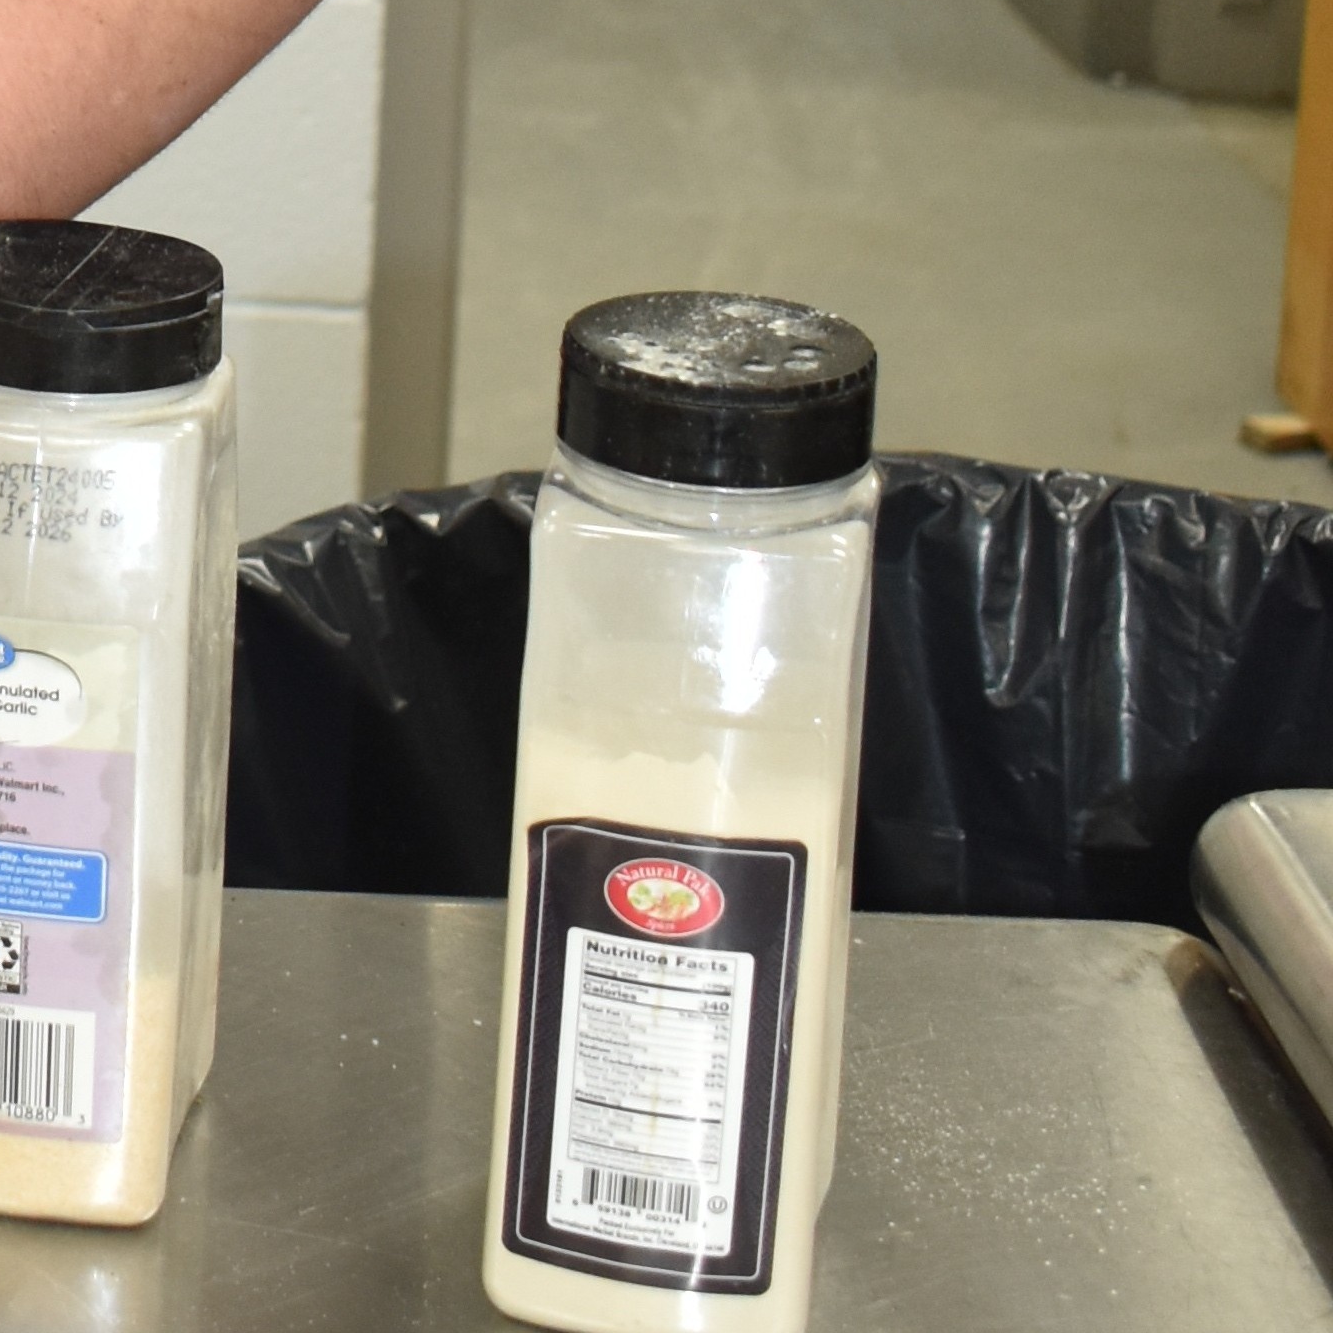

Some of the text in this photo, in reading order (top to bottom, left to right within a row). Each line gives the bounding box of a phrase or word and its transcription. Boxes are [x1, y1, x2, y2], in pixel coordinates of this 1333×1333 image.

[615, 864, 680, 887] Natural
[586, 940, 669, 966] Nutrition
[675, 955, 729, 973] Facts
[583, 982, 638, 1002] Calories
